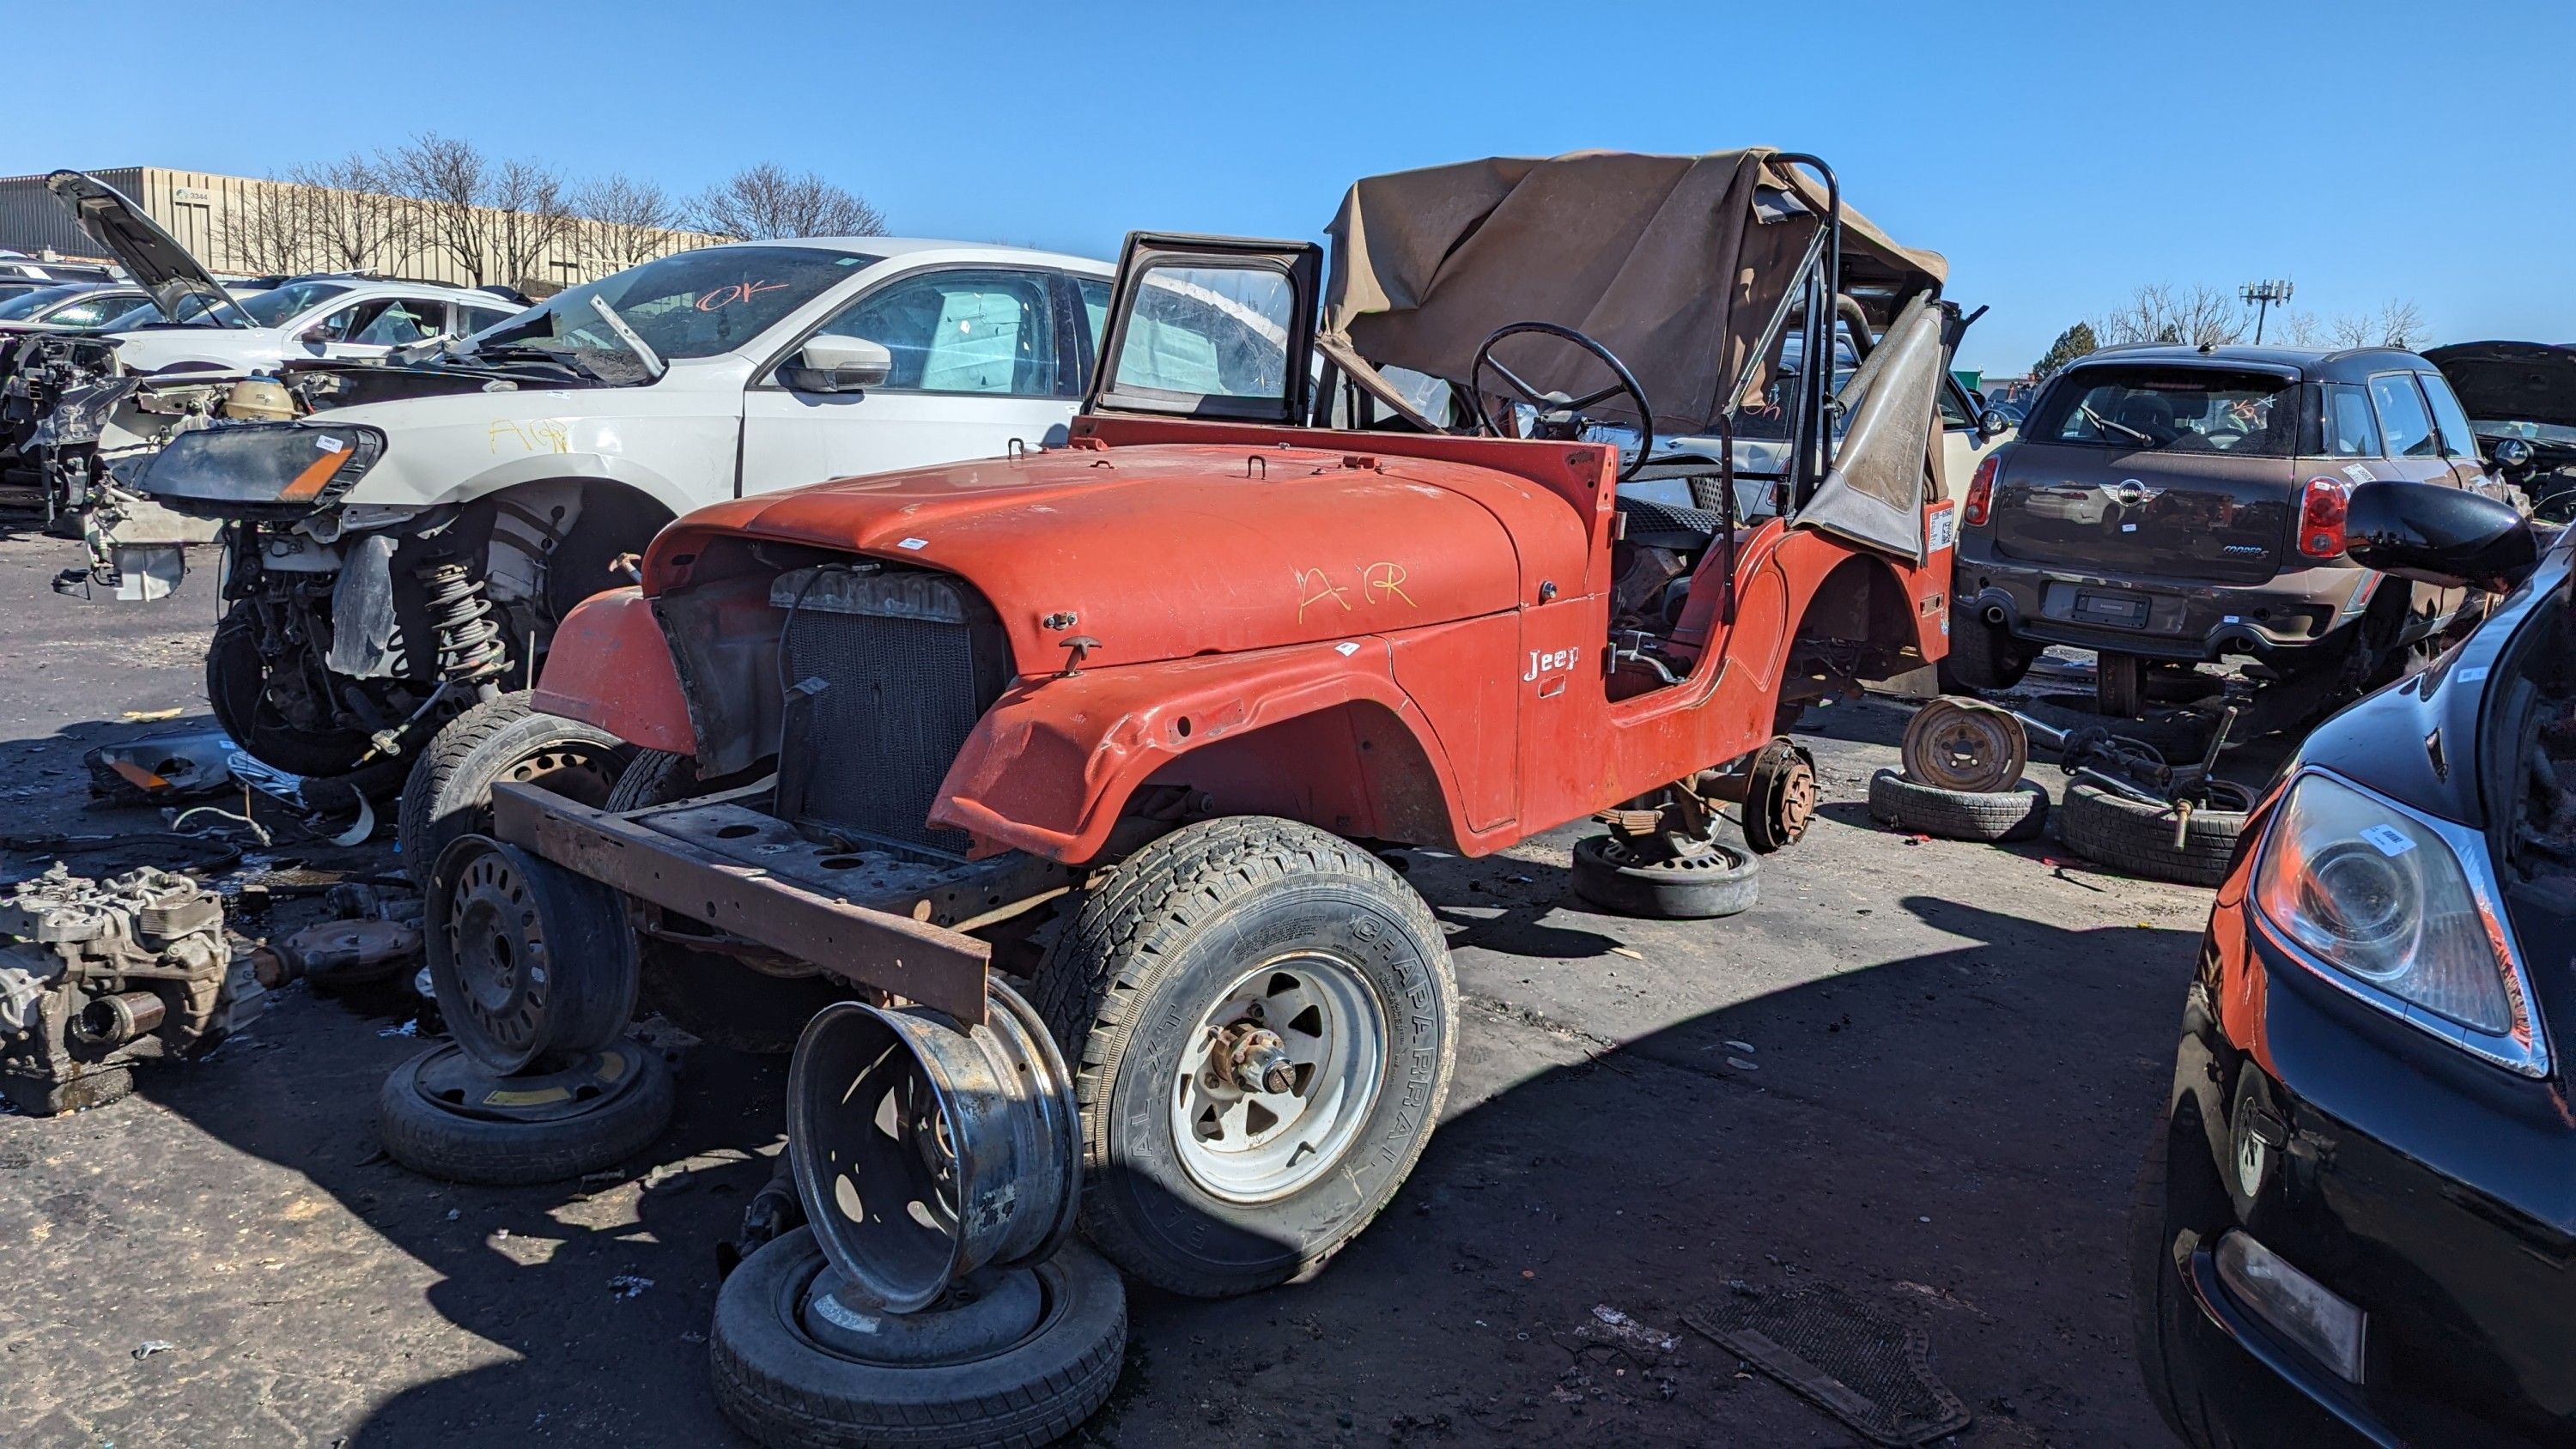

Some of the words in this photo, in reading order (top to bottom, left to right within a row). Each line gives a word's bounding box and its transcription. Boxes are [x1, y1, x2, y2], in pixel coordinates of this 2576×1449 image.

[696, 276, 790, 312] OK
[2119, 488, 2142, 497] MINI
[2223, 545, 2263, 555] COOPER
[2256, 550, 2269, 559] S
[1523, 646, 1579, 682] Jeep
[1352, 915, 1434, 1167] CHAPARRAL
